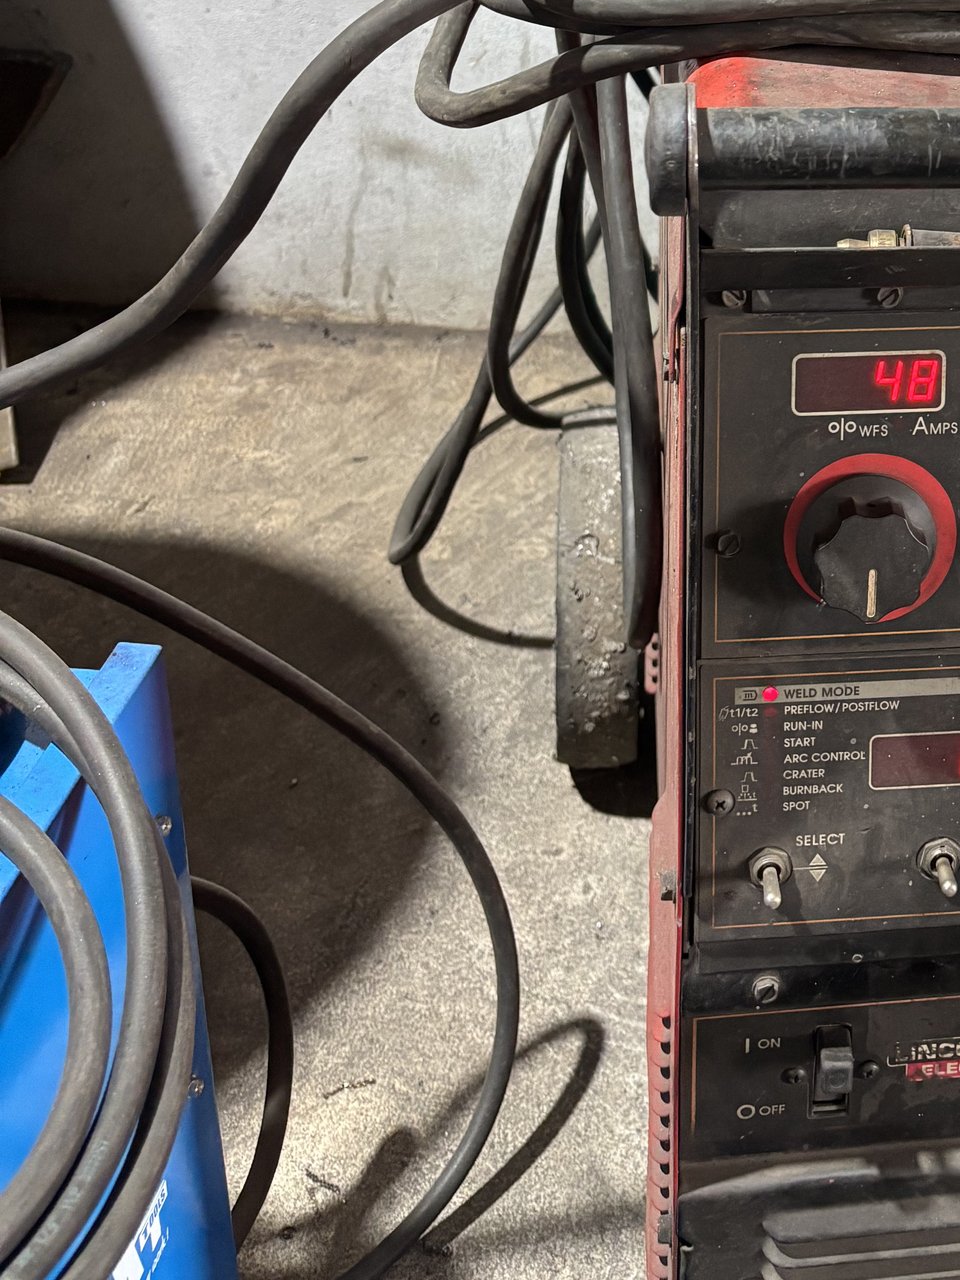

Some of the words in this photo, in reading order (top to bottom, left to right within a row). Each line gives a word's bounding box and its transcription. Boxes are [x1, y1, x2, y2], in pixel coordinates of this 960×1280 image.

[875, 359, 938, 401] 48
[859, 424, 889, 437] WFS
[912, 416, 958, 435] AMPS
[783, 688, 817, 700] WELD
[821, 686, 860, 697] MODE
[783, 720, 823, 731] RUN-IN
[783, 736, 817, 748] START
[783, 753, 808, 764] ARC
[811, 751, 866, 762] CONTROL
[783, 768, 825, 780] CRATER
[783, 784, 843, 796] BURNBACK
[782, 800, 811, 811] SPOT
[795, 832, 846, 847] SELECT
[758, 1037, 781, 1049] ON
[759, 1103, 786, 1116] OFF
